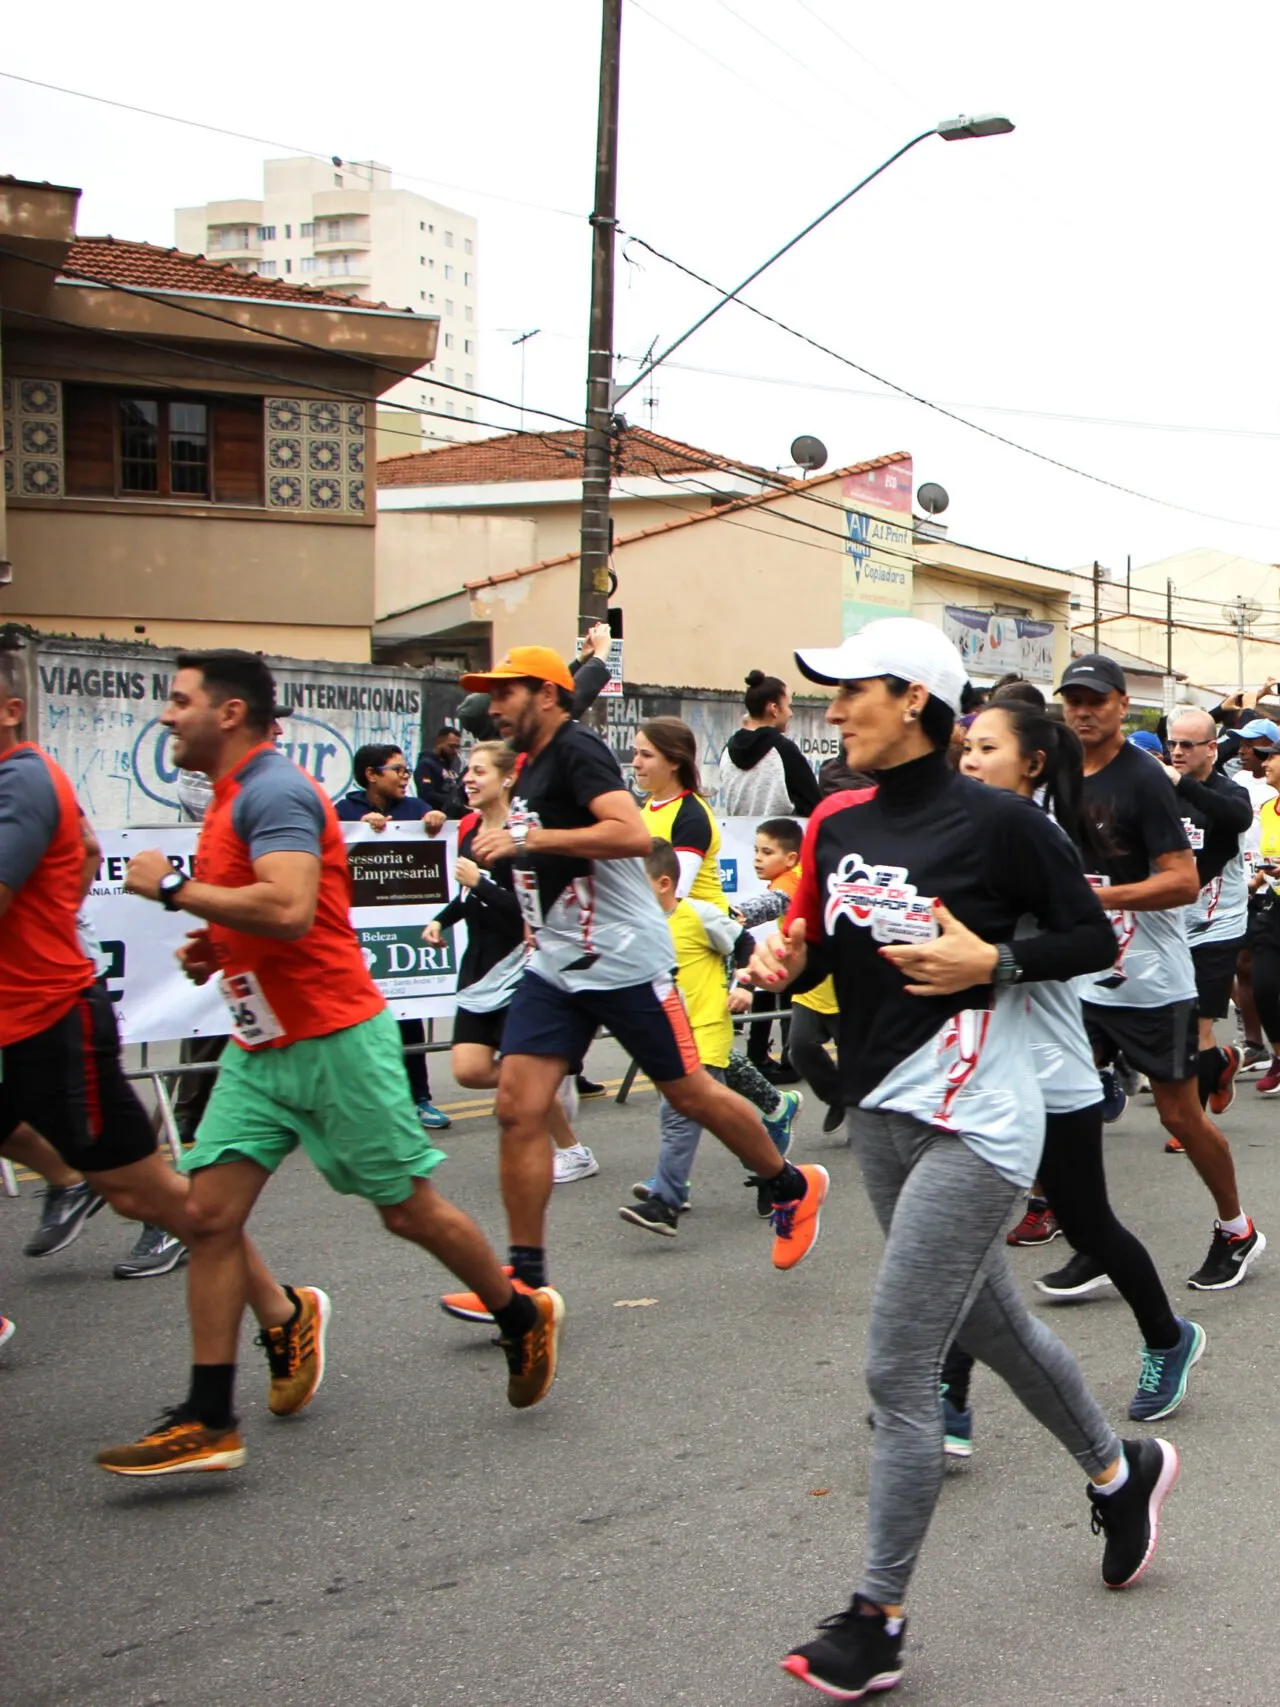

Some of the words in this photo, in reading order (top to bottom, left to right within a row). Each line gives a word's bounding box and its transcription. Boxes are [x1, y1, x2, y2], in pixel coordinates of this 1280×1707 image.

[885, 526, 908, 544] Print
[39, 666, 145, 699] VIAGENS
[283, 682, 421, 714] INTERNACIONAIS
[406, 853, 414, 864] e
[353, 864, 440, 884] Empresarial
[362, 931, 398, 942] Beleza
[386, 943, 451, 972] DRI
